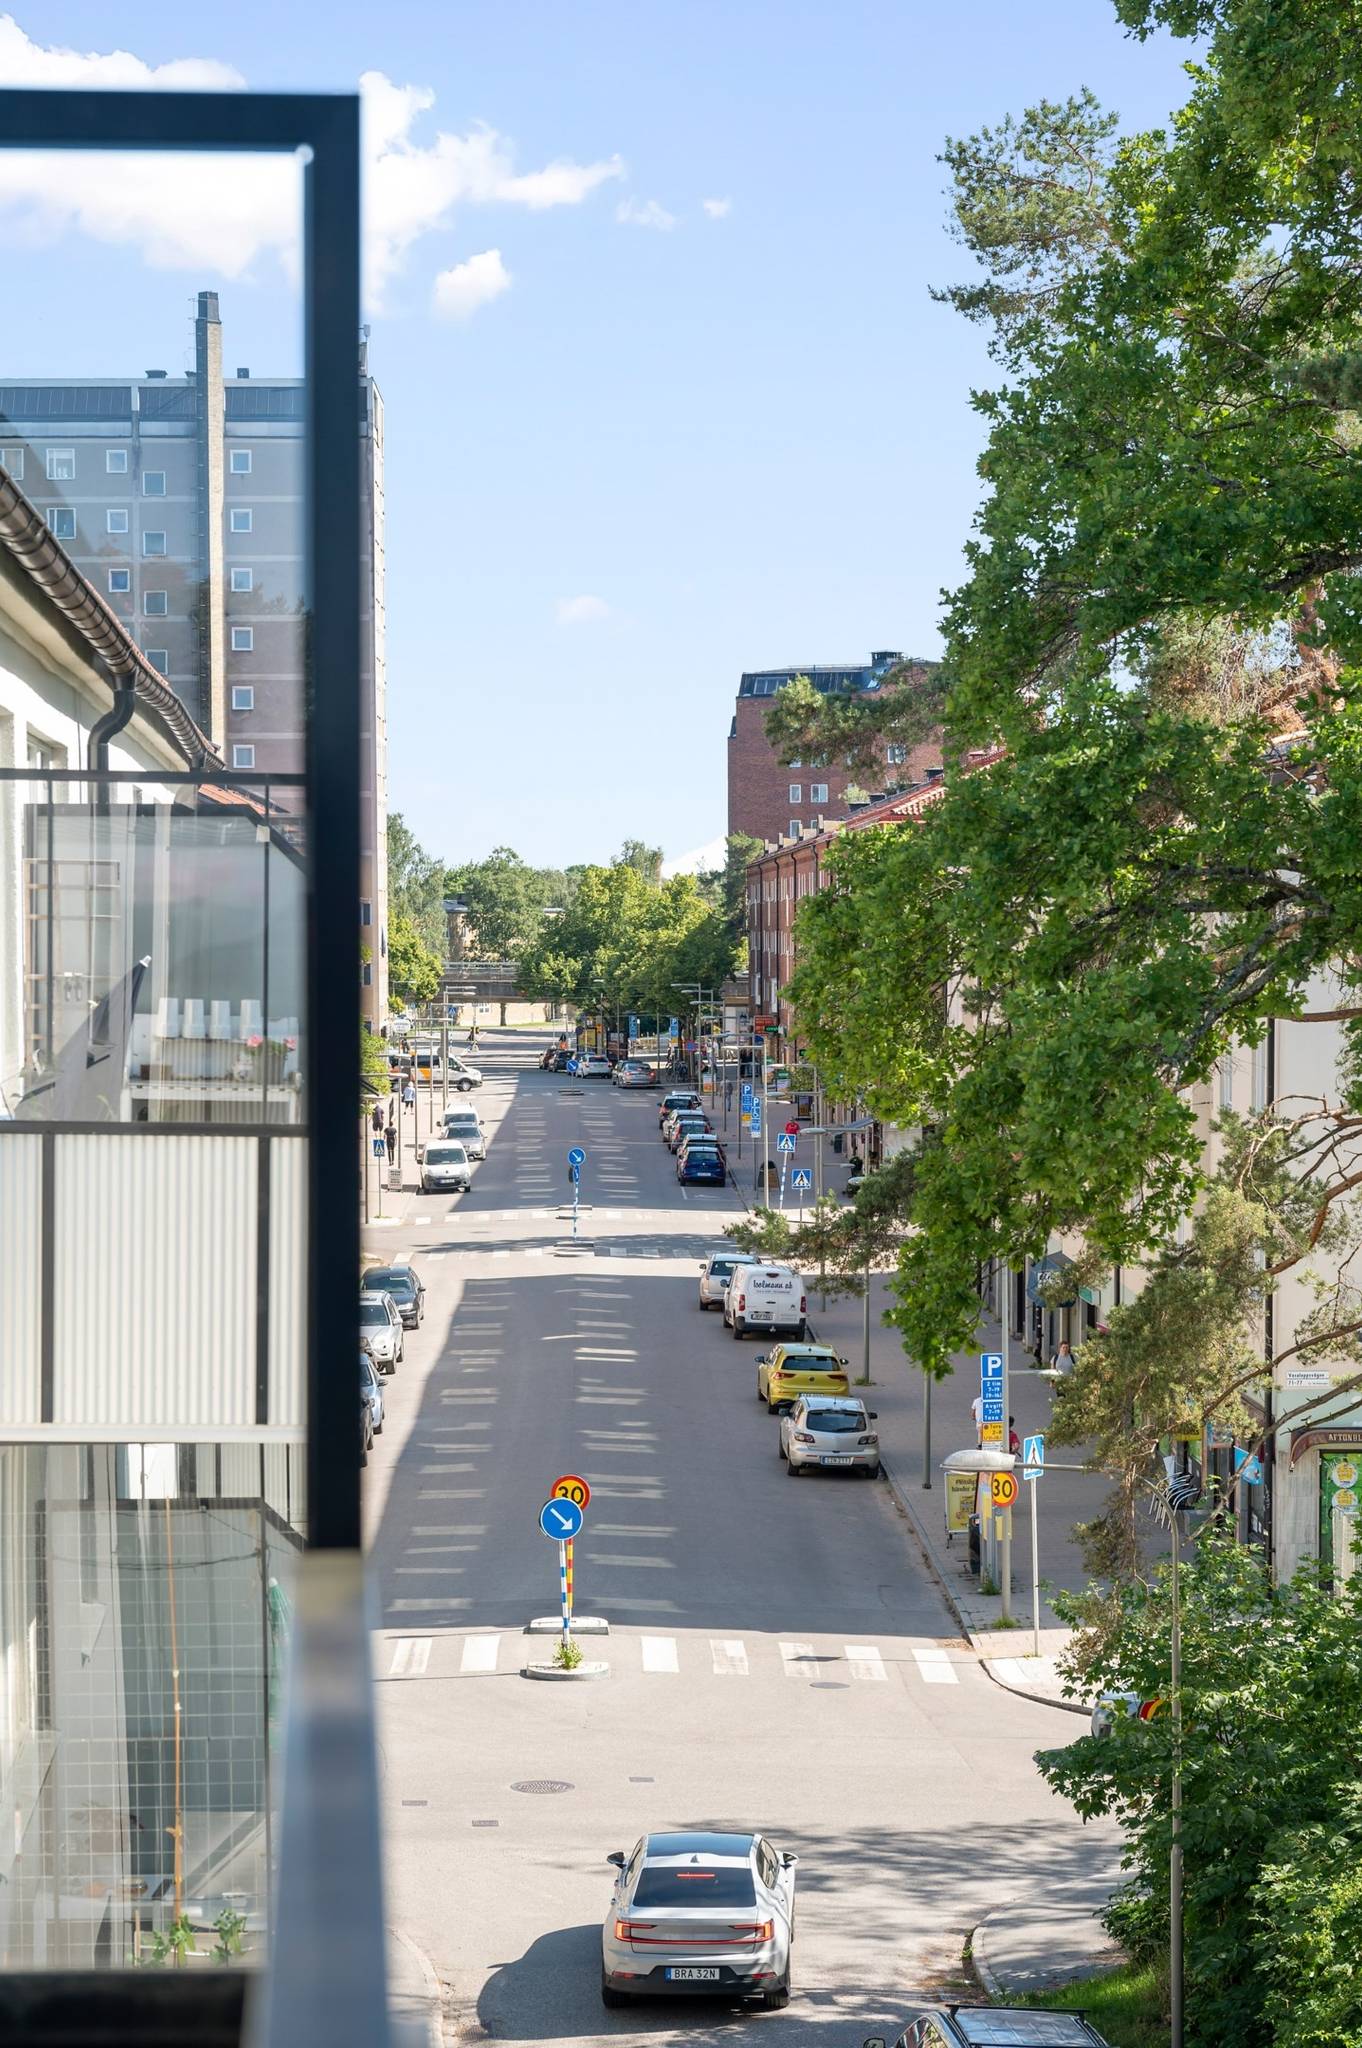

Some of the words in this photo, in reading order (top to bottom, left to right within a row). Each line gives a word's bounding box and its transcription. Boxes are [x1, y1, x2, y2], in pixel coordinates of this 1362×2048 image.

[744, 1085, 750, 1094] P
[753, 1097, 759, 1106] P
[987, 1356, 1002, 1377] P
[558, 1486, 584, 1504] 30
[992, 1479, 1012, 1498] 30
[674, 1969, 693, 1978] BRA
[696, 1969, 716, 1978] 32N
